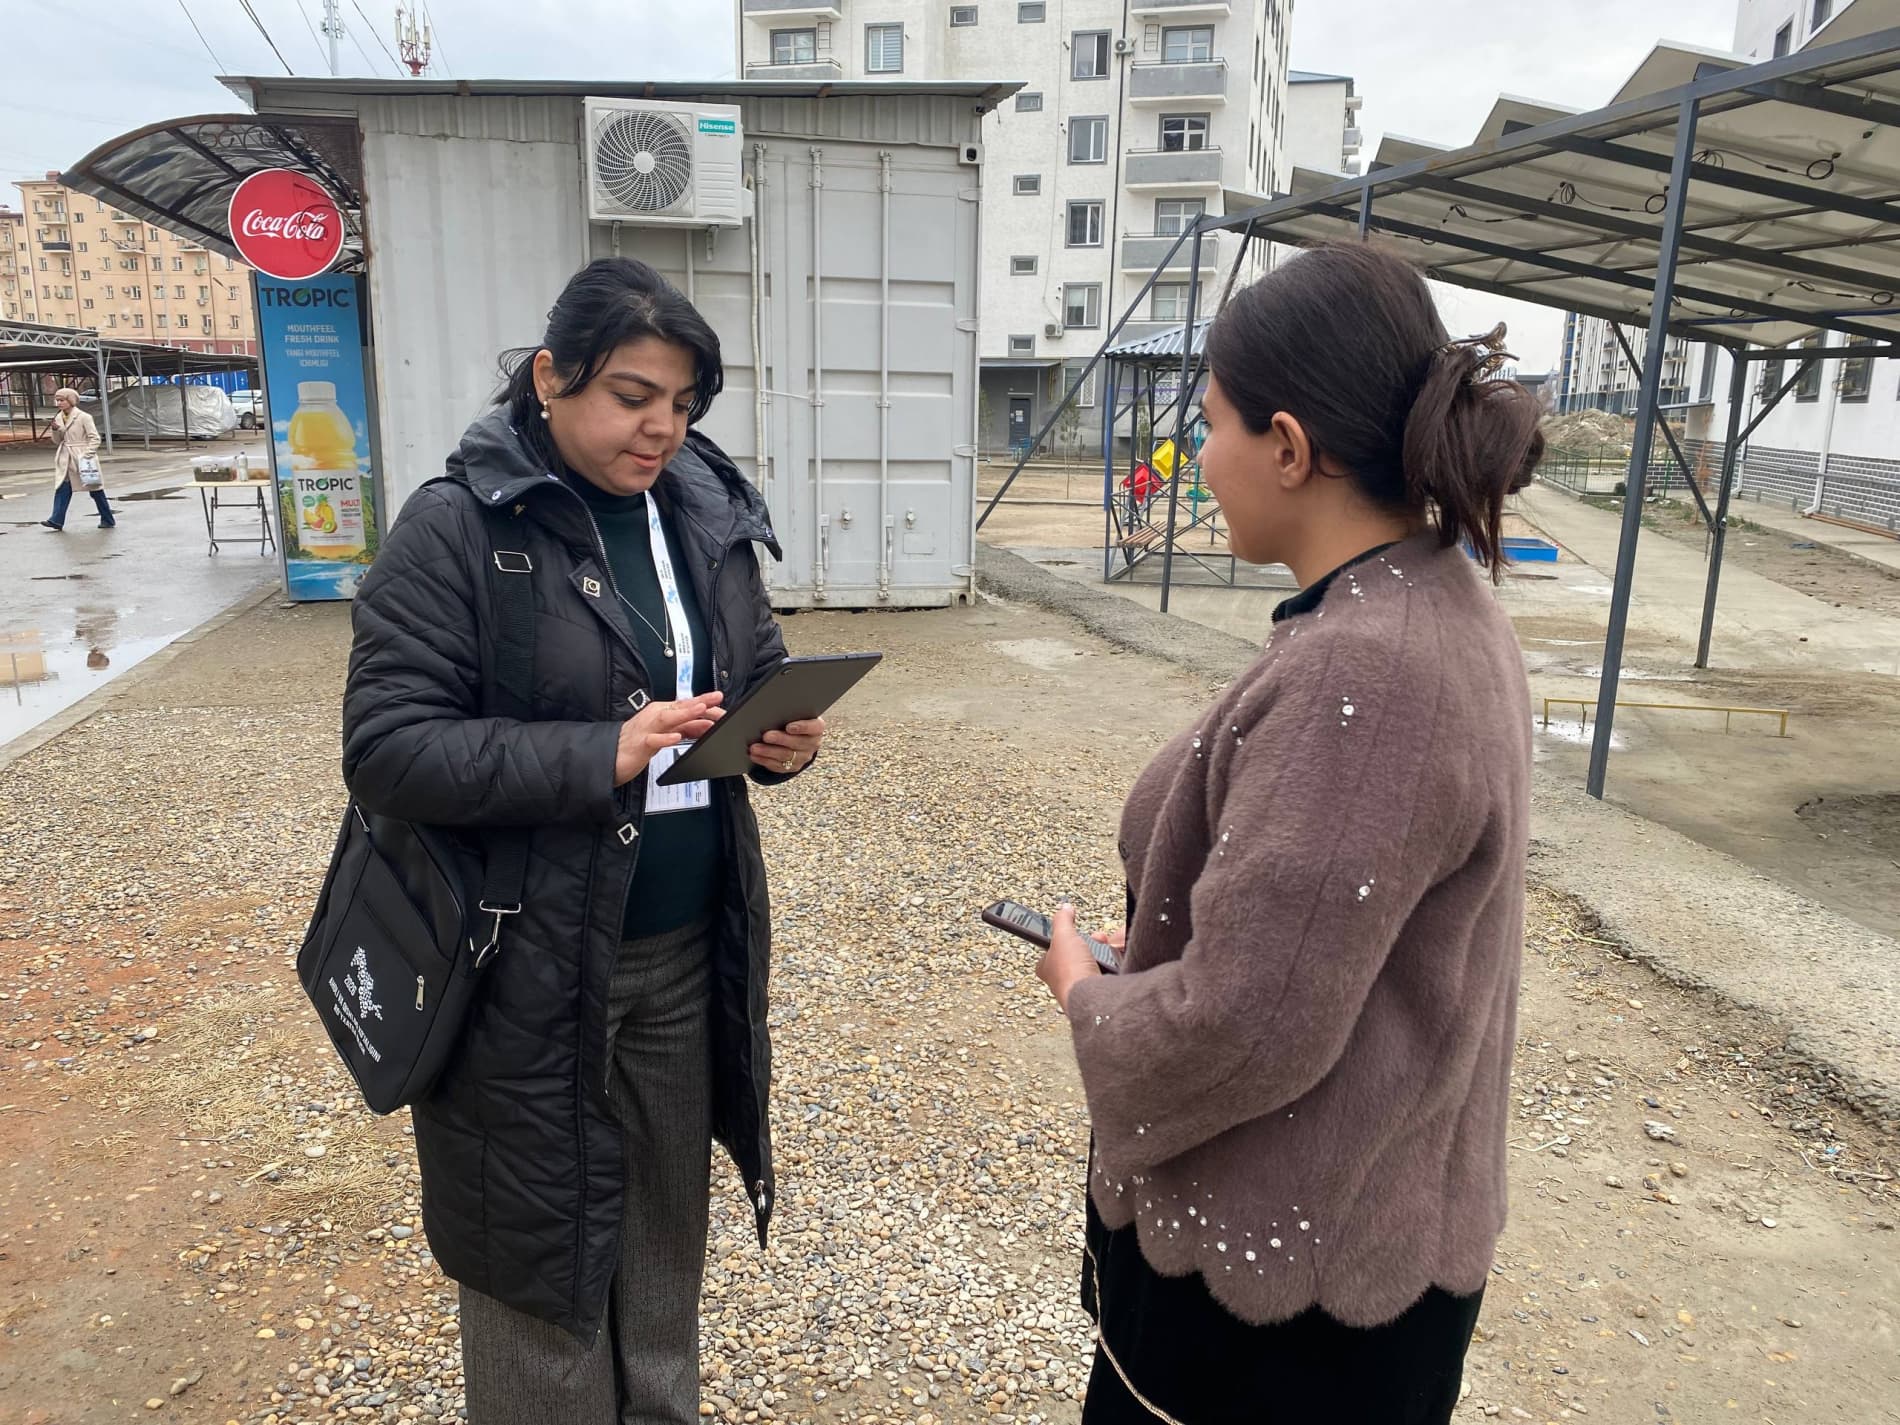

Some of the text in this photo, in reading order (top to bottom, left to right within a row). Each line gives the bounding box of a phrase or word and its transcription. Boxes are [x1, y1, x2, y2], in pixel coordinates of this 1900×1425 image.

[700, 122, 734, 131] Hisense
[242, 208, 328, 240] Coca-Cola
[261, 287, 351, 307] TROPIC
[287, 324, 337, 333] MOUTHFEEL
[284, 335, 340, 343] FRESH DRINK
[298, 478, 353, 491] TROPIC
